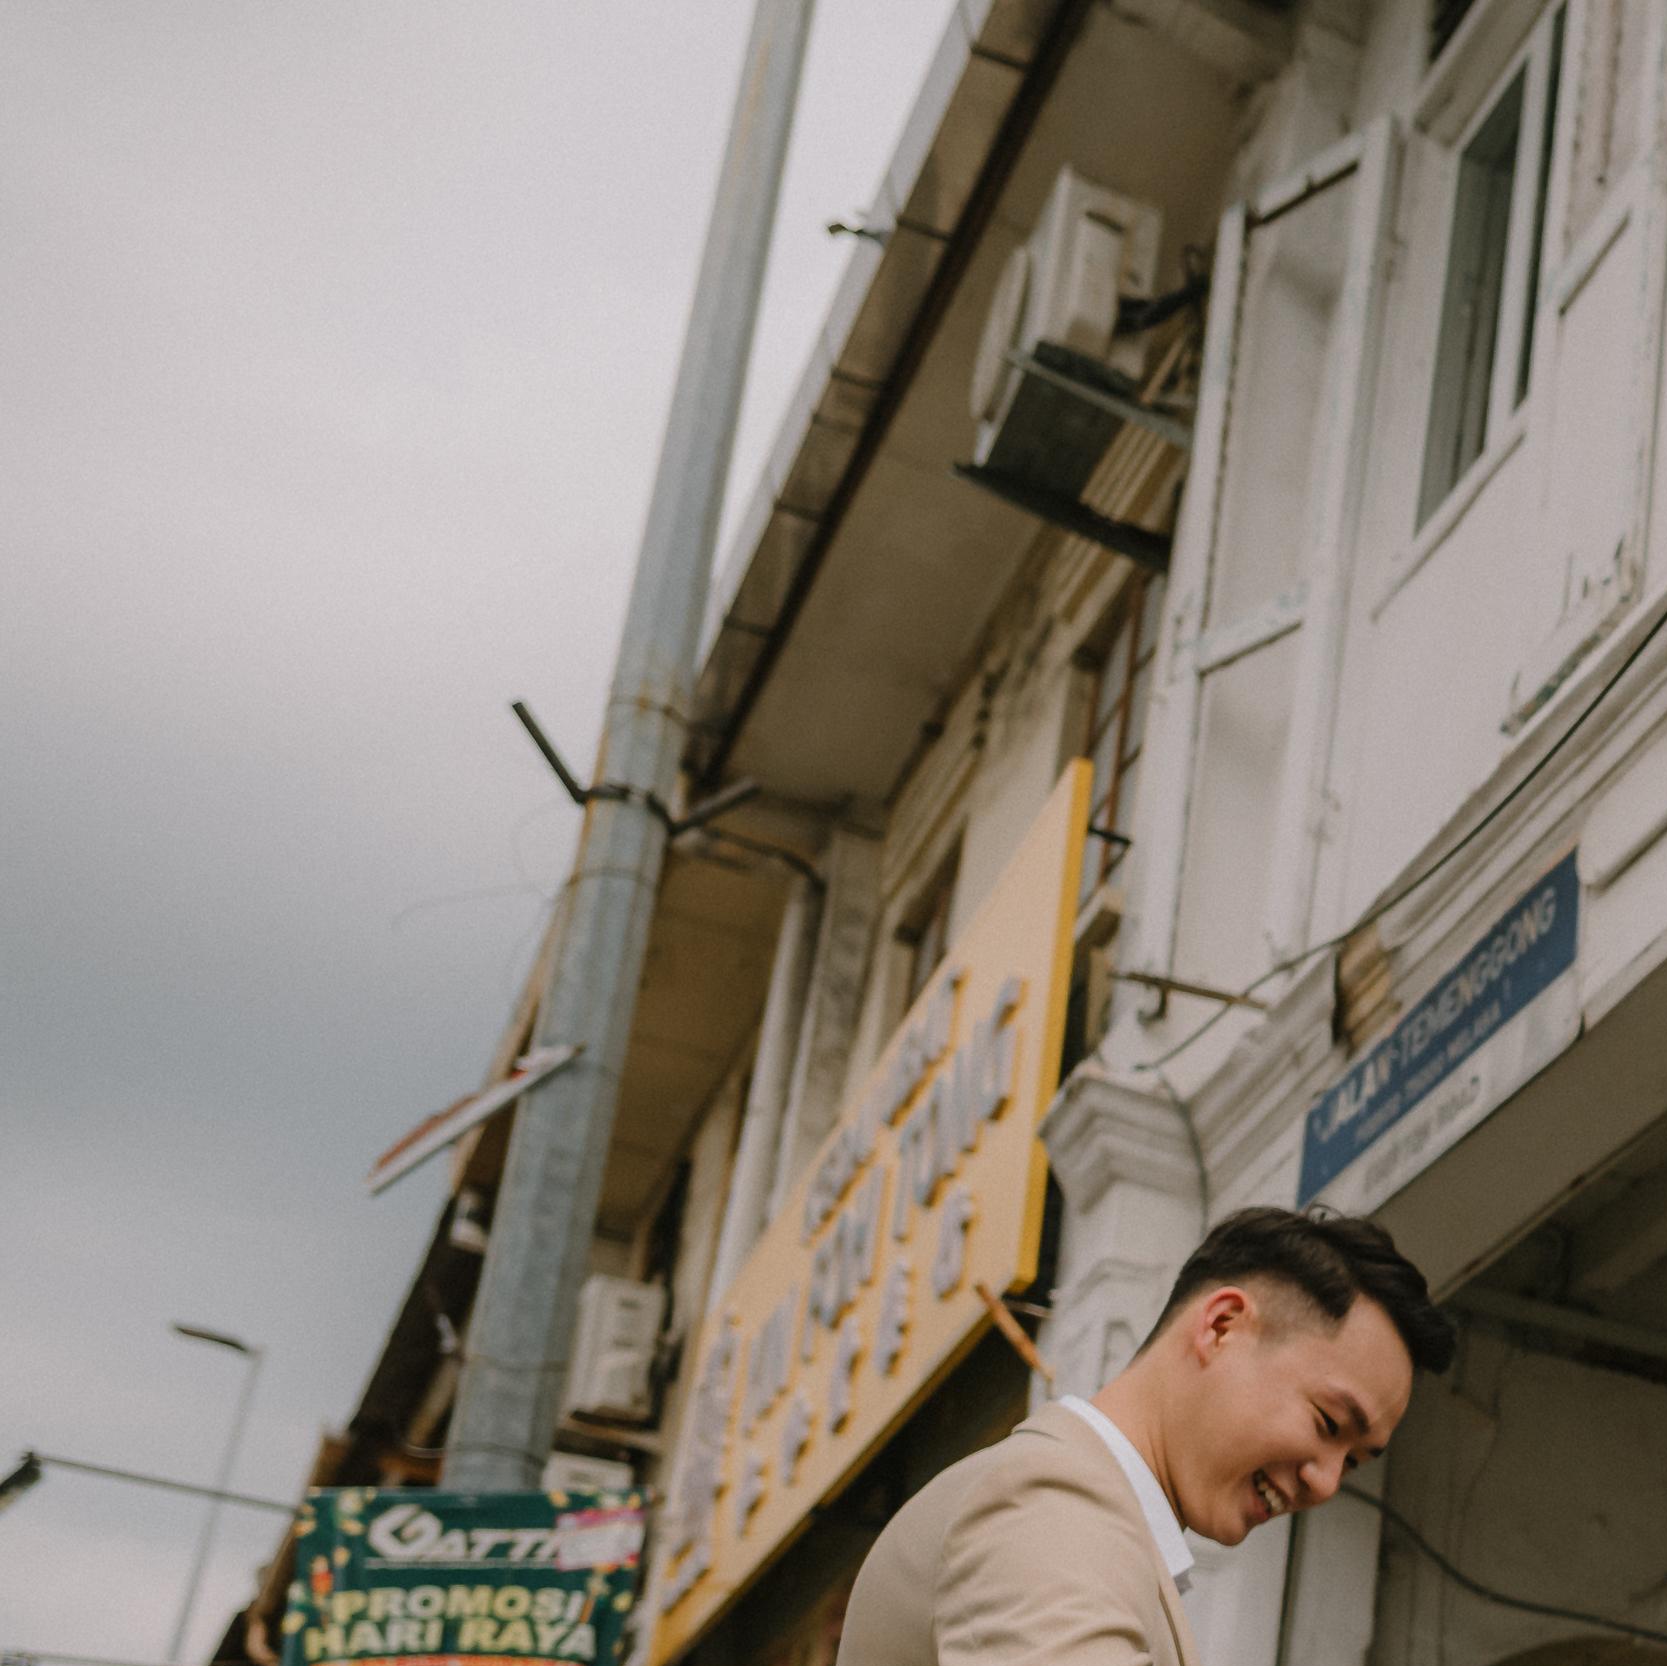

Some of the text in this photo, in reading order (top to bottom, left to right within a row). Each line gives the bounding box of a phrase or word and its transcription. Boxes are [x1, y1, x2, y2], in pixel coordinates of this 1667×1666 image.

[331, 1584, 587, 1623] PROMOSI
[305, 1617, 597, 1660] HARI RAYA
